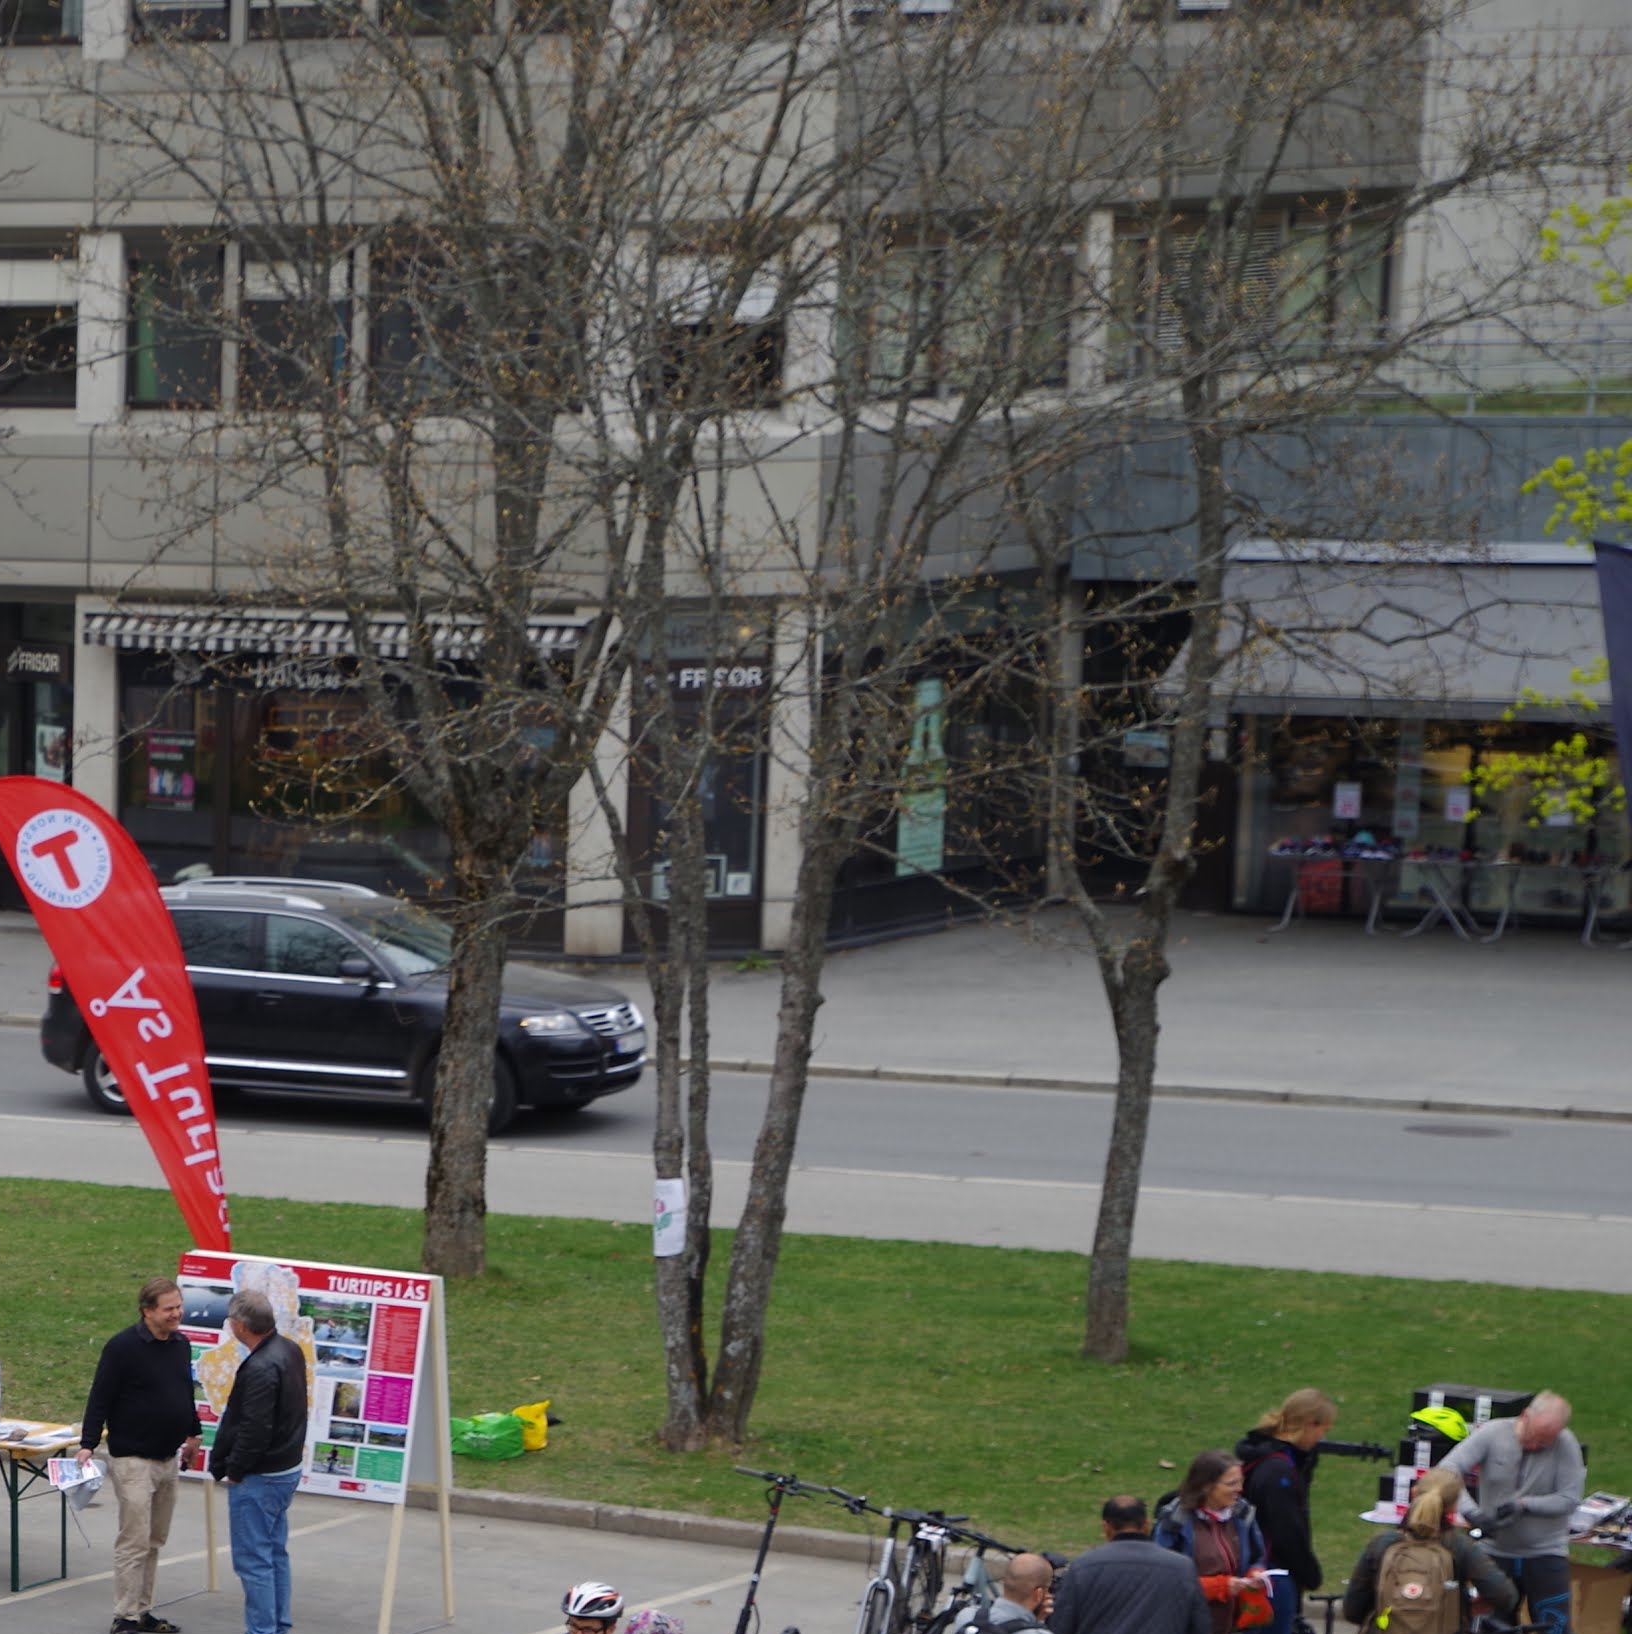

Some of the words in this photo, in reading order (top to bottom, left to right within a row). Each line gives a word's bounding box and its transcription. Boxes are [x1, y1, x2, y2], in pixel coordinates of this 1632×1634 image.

[327, 1274, 394, 1299] TURTIPS
[394, 1281, 403, 1299] I
[402, 1279, 426, 1301] ÅS
